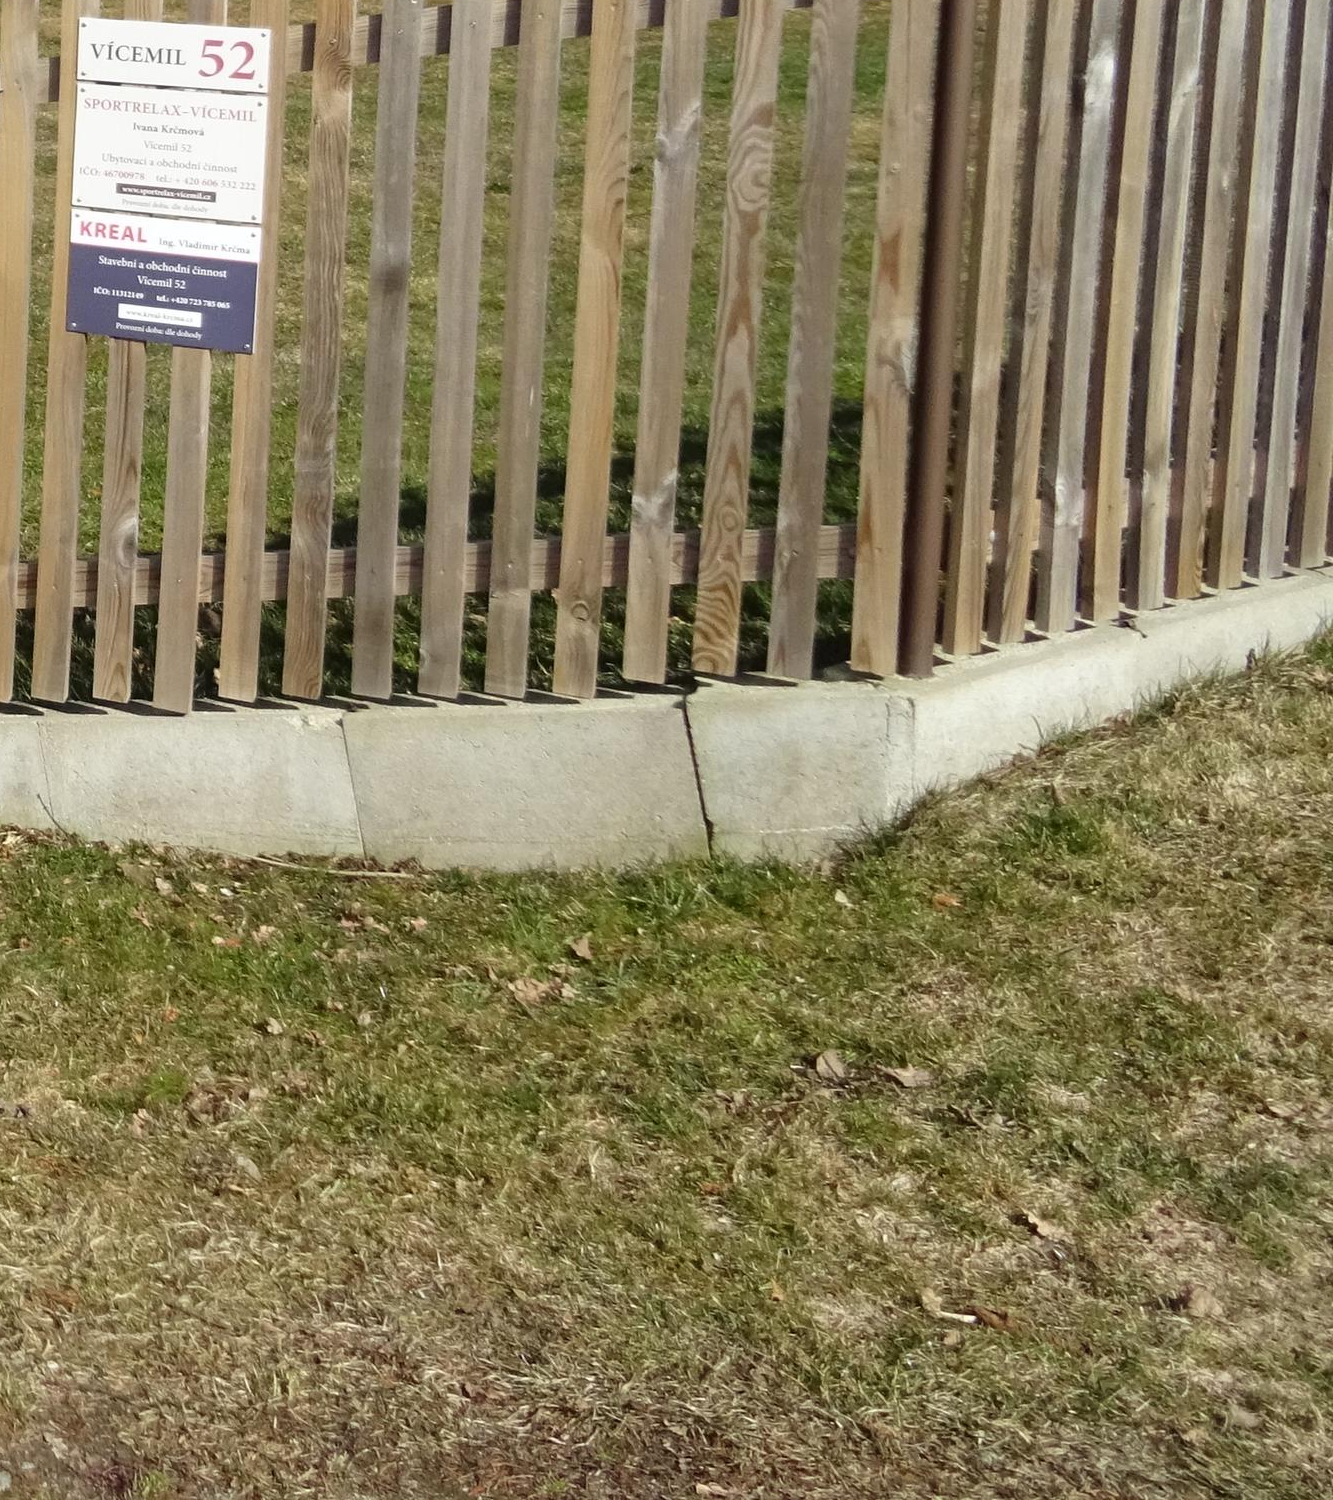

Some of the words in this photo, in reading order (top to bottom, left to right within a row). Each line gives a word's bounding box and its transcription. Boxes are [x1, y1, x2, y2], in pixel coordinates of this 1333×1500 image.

[90, 41, 187, 66] VÍCEMIL
[198, 39, 256, 80] 52
[133, 123, 158, 133] Ivana
[161, 124, 205, 137] Krčmová
[144, 140, 178, 152] Vícemil
[181, 144, 193, 153] 52
[157, 159, 201, 171] obchodní
[203, 162, 238, 174] činnost
[80, 221, 148, 243] KREAL
[159, 237, 176, 248] Ing.
[221, 244, 251, 255] Krčma
[98, 255, 137, 269] Stavební
[146, 261, 191, 275] obchodní
[192, 264, 227, 278] činnost
[137, 275, 173, 289] Vícemil
[174, 279, 187, 289] 52
